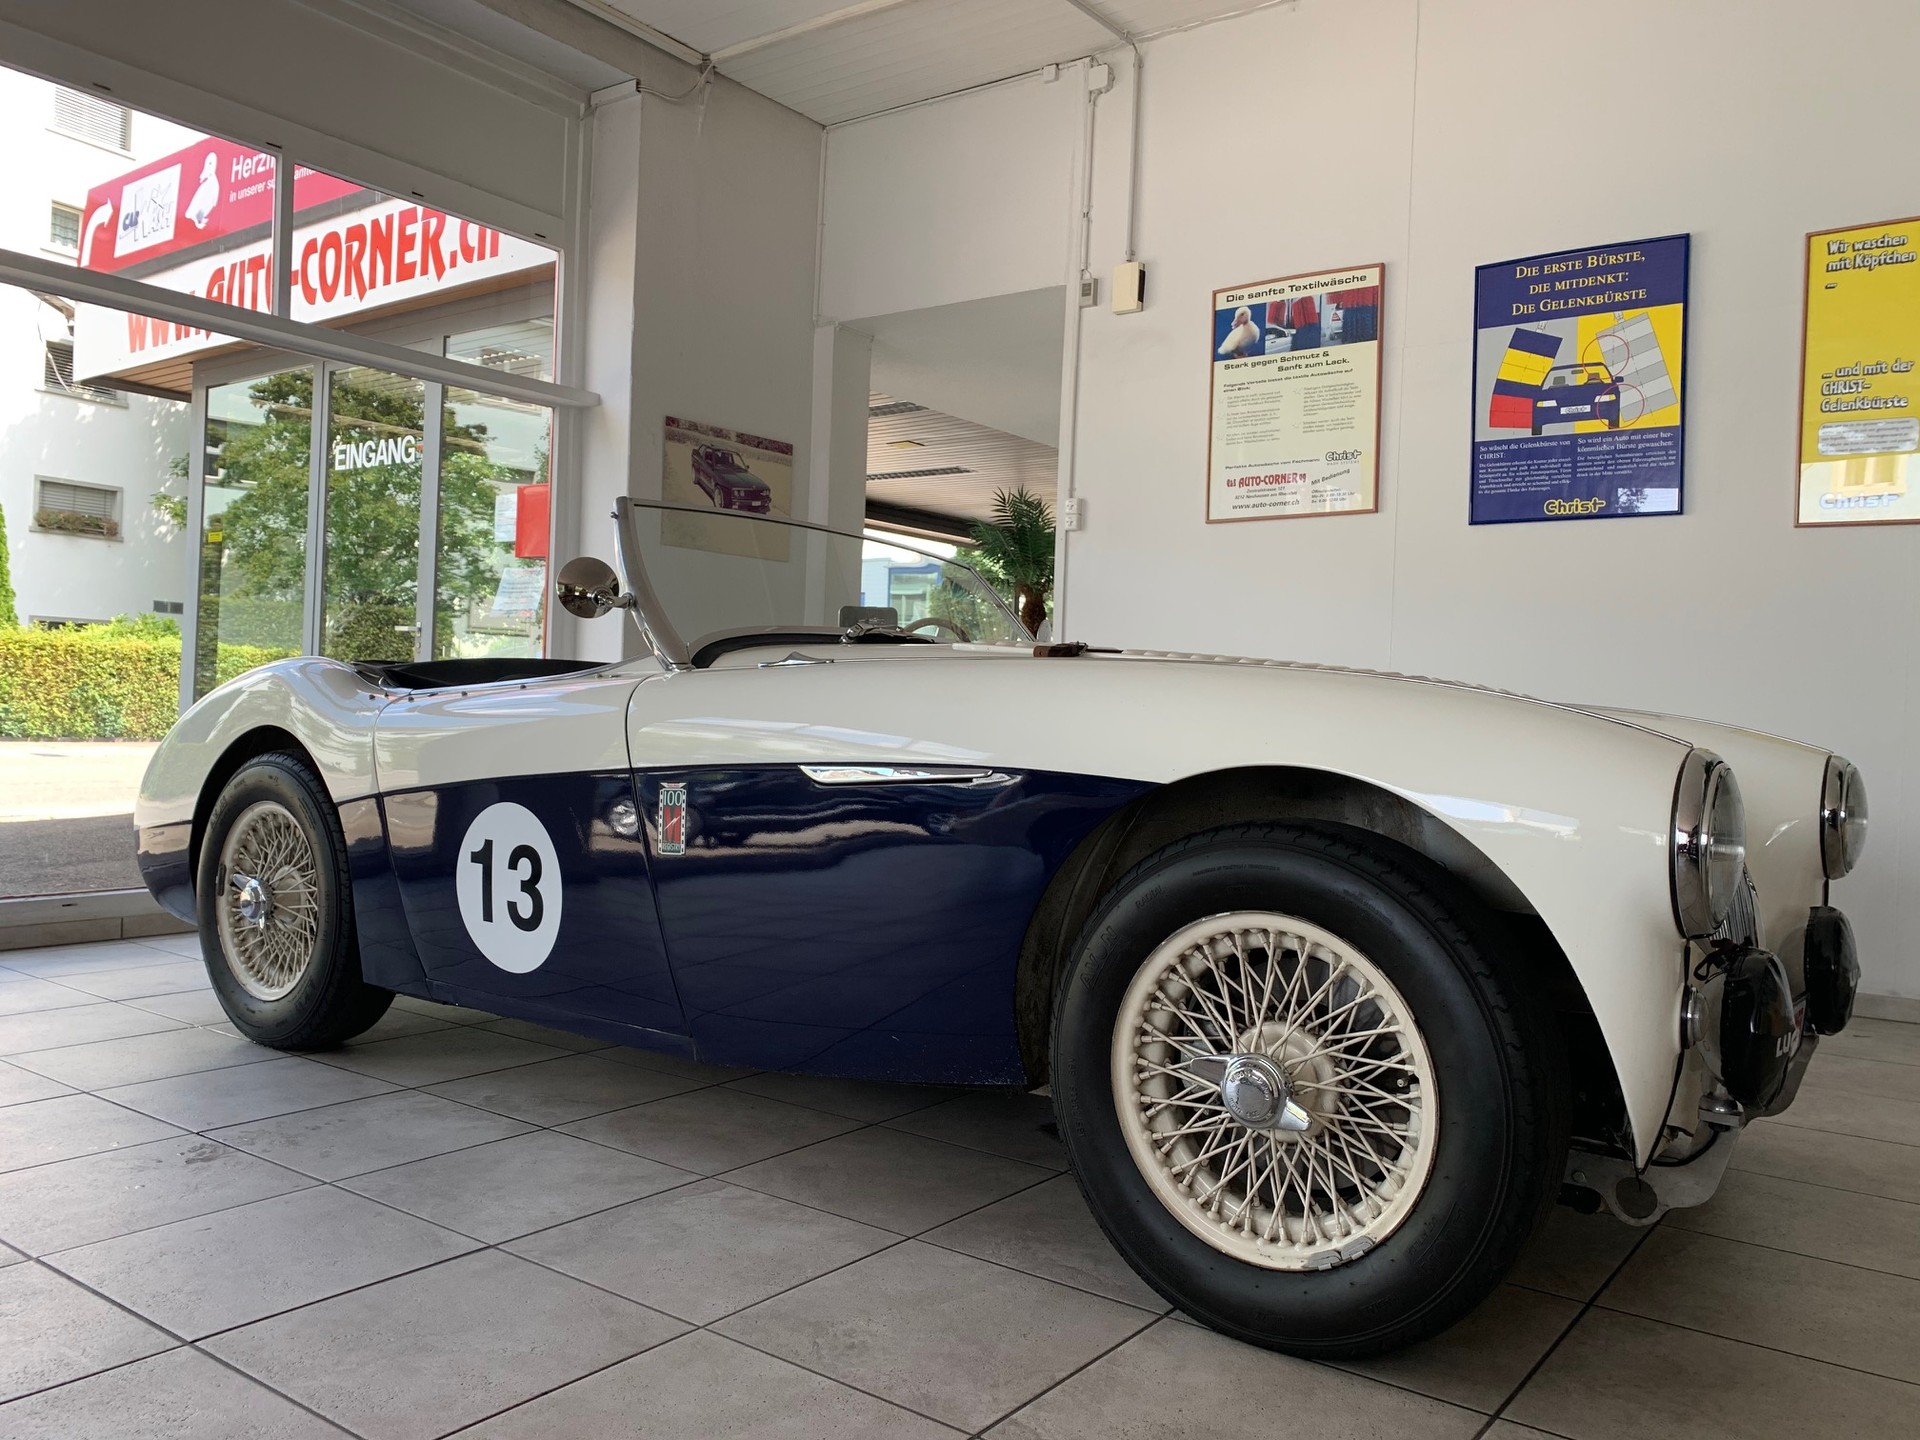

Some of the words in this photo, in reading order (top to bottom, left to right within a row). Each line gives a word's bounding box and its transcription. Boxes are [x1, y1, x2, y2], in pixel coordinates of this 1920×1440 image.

[229, 190, 236, 203] in
[238, 181, 266, 200] unserer
[1827, 240, 1851, 255] Wir
[1852, 233, 1909, 252] waschen
[1826, 257, 1853, 273] mit
[1852, 250, 1918, 272] Köpfchen
[1226, 293, 1245, 303] Die
[1248, 288, 1285, 300] sanfte
[1288, 274, 1367, 293] Textilwäsche
[1224, 362, 1249, 371] Stark
[1251, 358, 1278, 369] gegen
[1280, 352, 1320, 363] Schmutz
[1277, 364, 1303, 372] Sanft
[1326, 357, 1350, 366] Lack.
[1835, 361, 1861, 377] und
[1863, 361, 1888, 375] mit
[1891, 358, 1915, 373] der
[1822, 378, 1872, 396] CHRIST-
[1821, 394, 1909, 413] Gelenkbürste
[1479, 444, 1490, 452] So
[1519, 440, 1558, 449] Gelenkbürste
[1577, 444, 1615, 453] kömmlichen
[1616, 442, 1637, 451] Bürste
[1637, 440, 1674, 450] gewaschen:
[1587, 436, 1602, 444] wird
[334, 434, 417, 471] EINGANG
[1325, 449, 1362, 462] Christ
[1479, 452, 1506, 460] CHRIST:
[1238, 472, 1298, 488] AUTO-CORNER
[1310, 478, 1321, 486] Mit
[1322, 468, 1351, 482] Bedienung
[1231, 498, 1300, 510] www.auto-corner.ch
[1544, 496, 1606, 515] Christ
[663, 790, 683, 806] 100
[470, 838, 545, 932] 13
